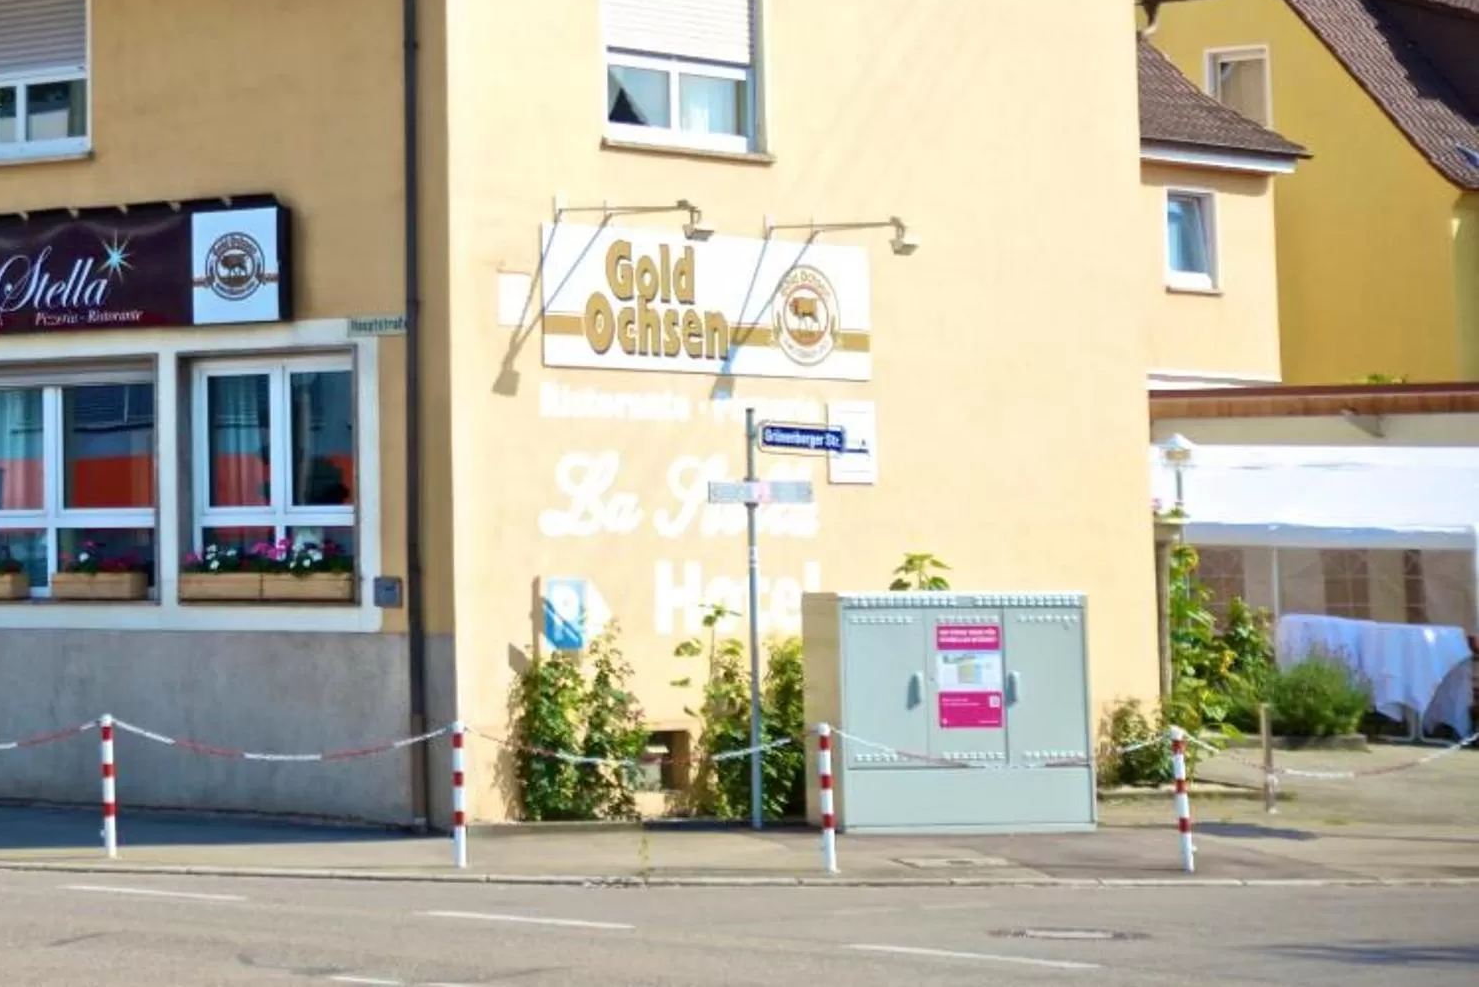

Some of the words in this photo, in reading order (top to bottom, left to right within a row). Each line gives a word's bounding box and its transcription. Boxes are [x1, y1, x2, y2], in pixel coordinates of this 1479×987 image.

[605, 239, 695, 305] Gold
[350, 316, 408, 331] Hauptstraß
[585, 291, 729, 361] Ochsen
